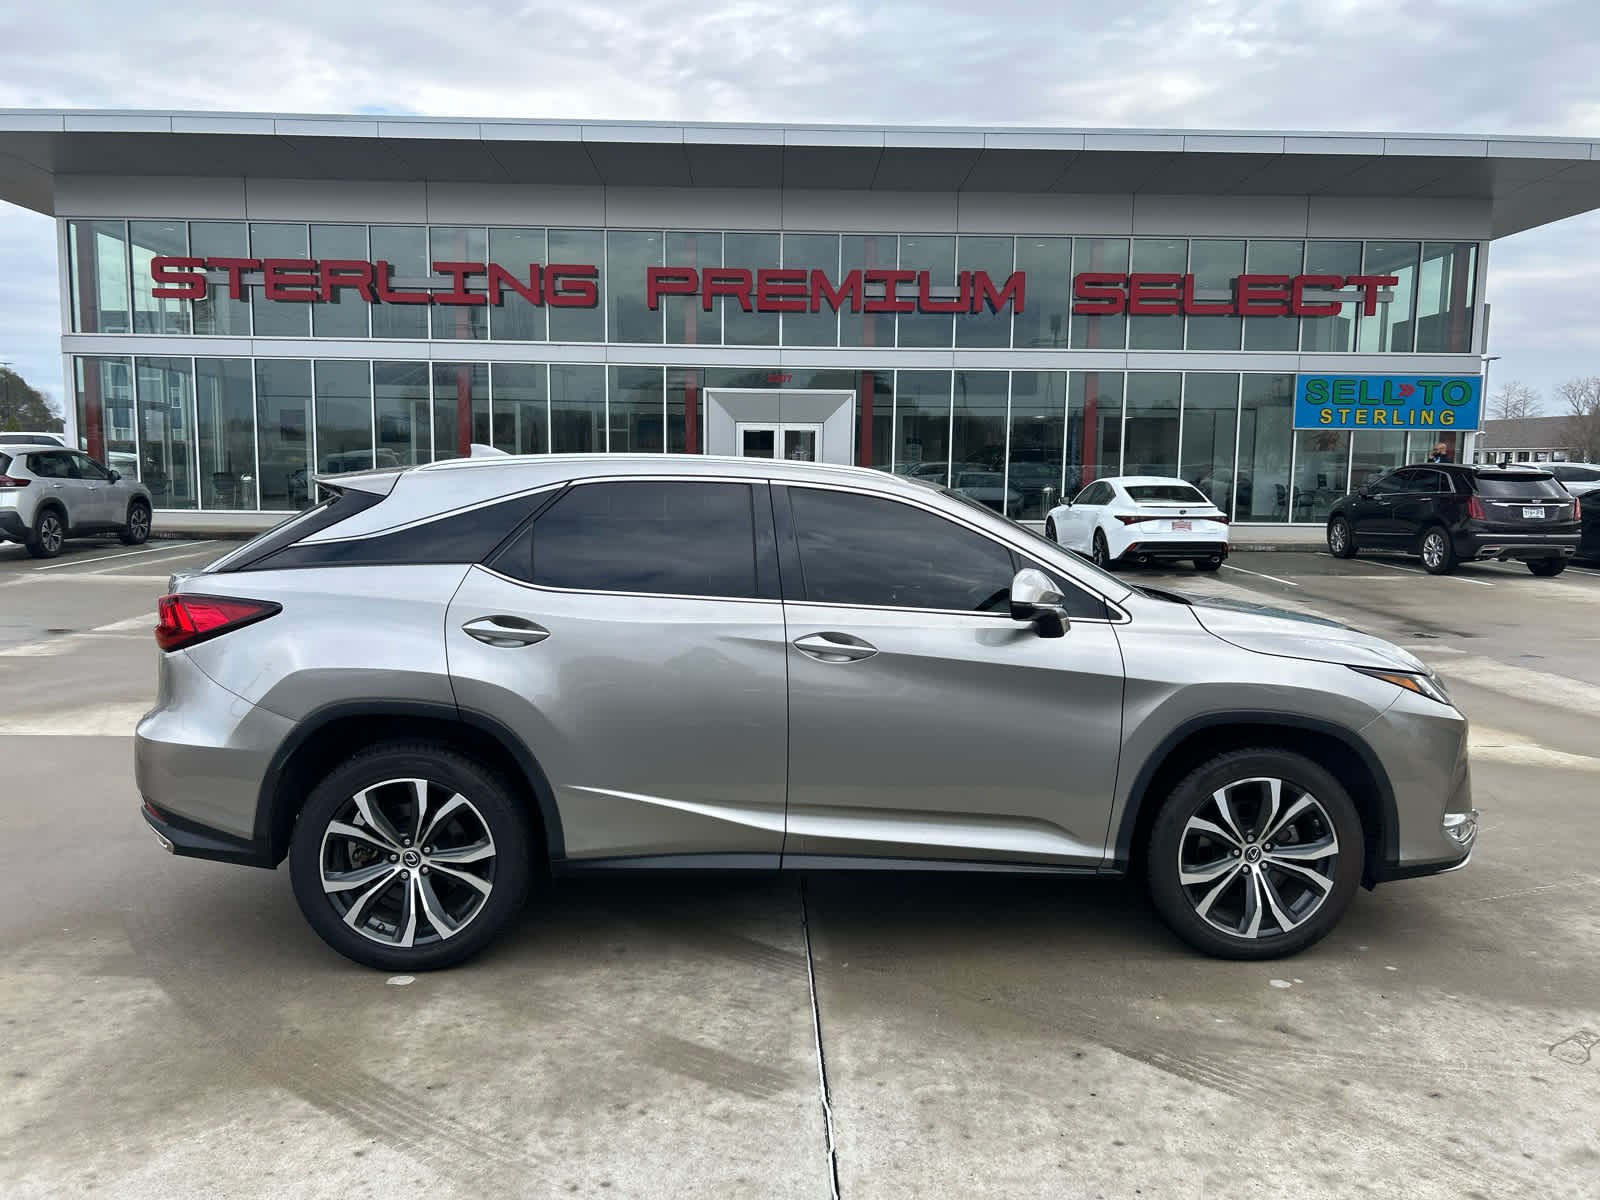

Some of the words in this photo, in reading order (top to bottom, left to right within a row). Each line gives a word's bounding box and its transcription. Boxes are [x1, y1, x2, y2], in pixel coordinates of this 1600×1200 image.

[151, 256, 598, 307] STERLING
[647, 266, 1025, 313] PREMIUM
[1072, 272, 1398, 317] SELECT
[1305, 379, 1405, 406] SELL
[1417, 380, 1472, 406] TO
[1320, 408, 1455, 425] STERLING
